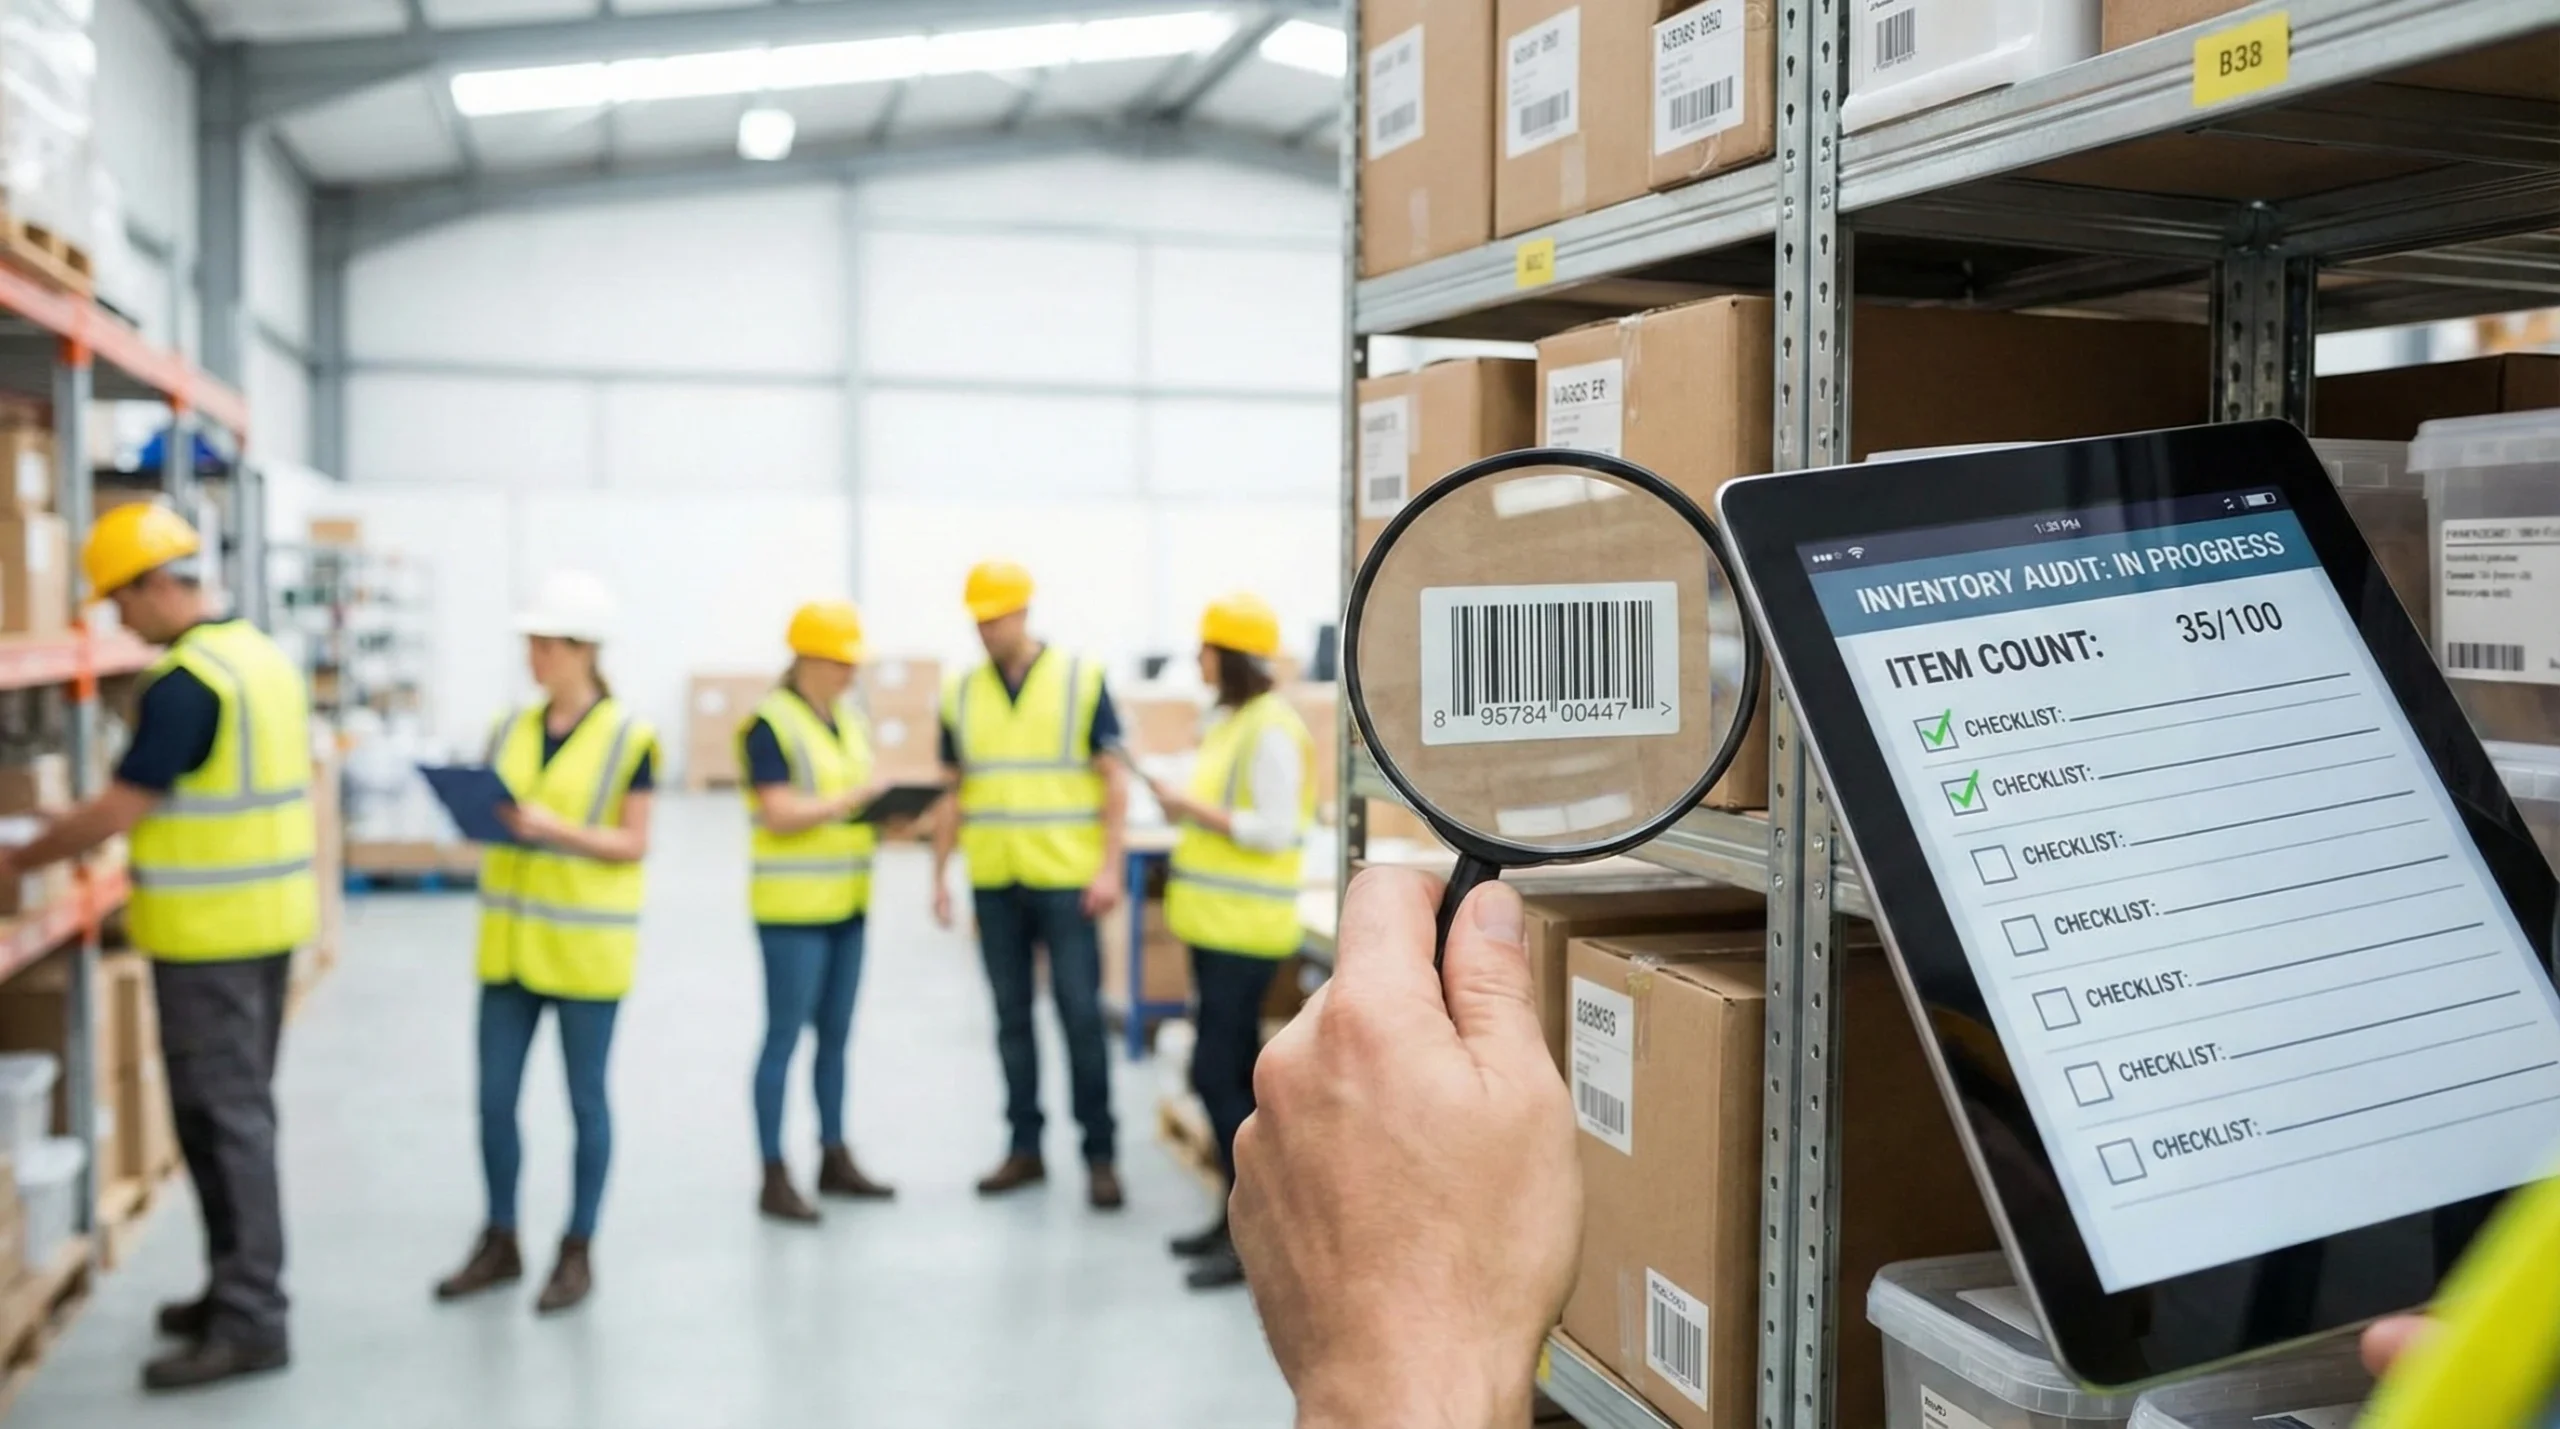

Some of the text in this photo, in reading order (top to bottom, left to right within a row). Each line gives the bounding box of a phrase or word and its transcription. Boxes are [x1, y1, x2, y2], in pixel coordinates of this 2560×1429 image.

[2219, 40, 2263, 77] B38
[1856, 531, 2285, 614] INVENTORY AUDIT: IN PROGRESS
[1885, 601, 2283, 689] ITEM COUNT: 35/100
[1432, 709, 1447, 729] 8
[1480, 704, 1548, 726] 95784
[1560, 701, 1628, 723] 00447
[1964, 706, 2066, 738] CHECKLIST:
[1992, 763, 2095, 797] CHECKLIST:
[2022, 830, 2126, 865] CHECKLIST:
[2054, 899, 2160, 935] CHECKLIST:
[2086, 970, 2192, 1008] CHECKLIST:
[2118, 1042, 2226, 1082] CHECKLIST:
[2152, 1117, 2261, 1160] CHECKLIST:
